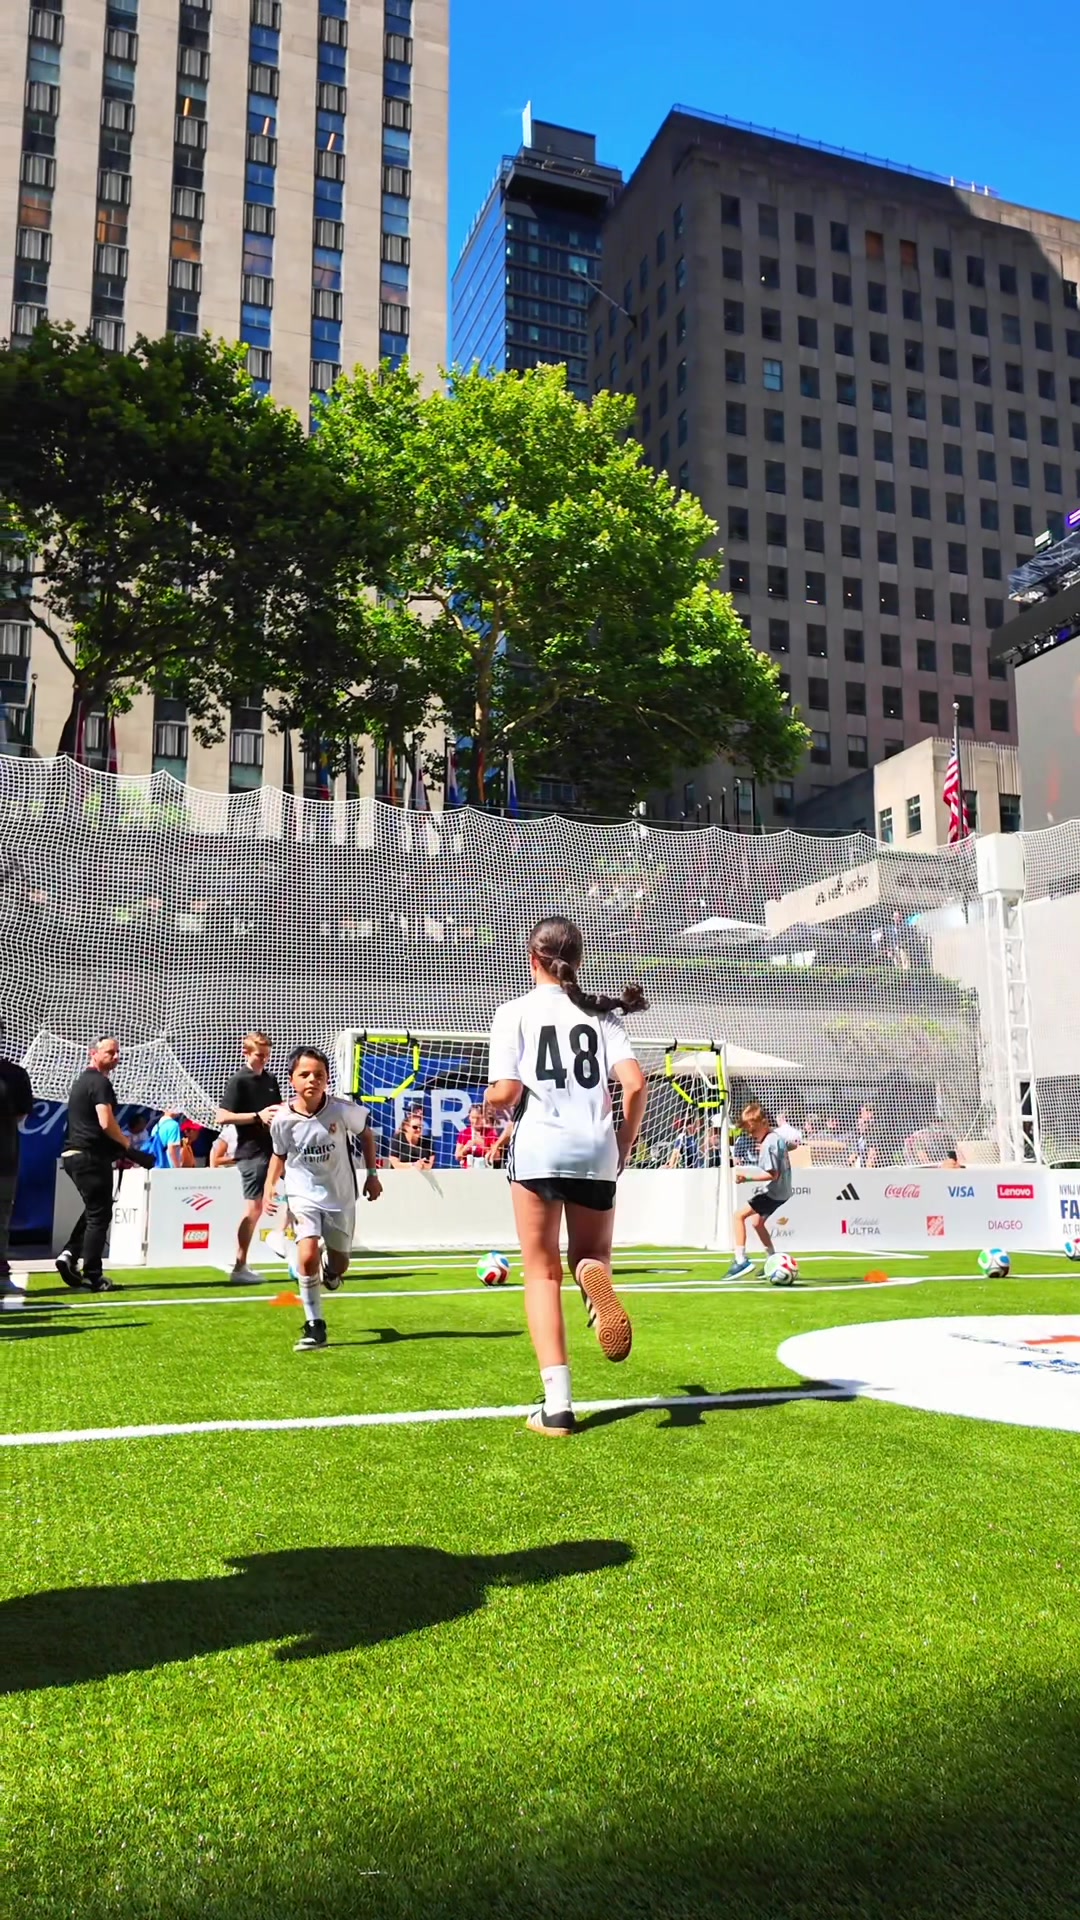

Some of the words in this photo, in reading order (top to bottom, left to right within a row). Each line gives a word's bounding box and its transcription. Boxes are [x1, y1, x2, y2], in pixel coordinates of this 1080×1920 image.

[535, 1024, 600, 1089] 48
[948, 1186, 975, 1198] VISA
[999, 1187, 1031, 1197] Lenovo
[114, 1207, 138, 1224] EXIT
[988, 1220, 1023, 1230] DIAGEO
[848, 1226, 881, 1236] ULTRA
